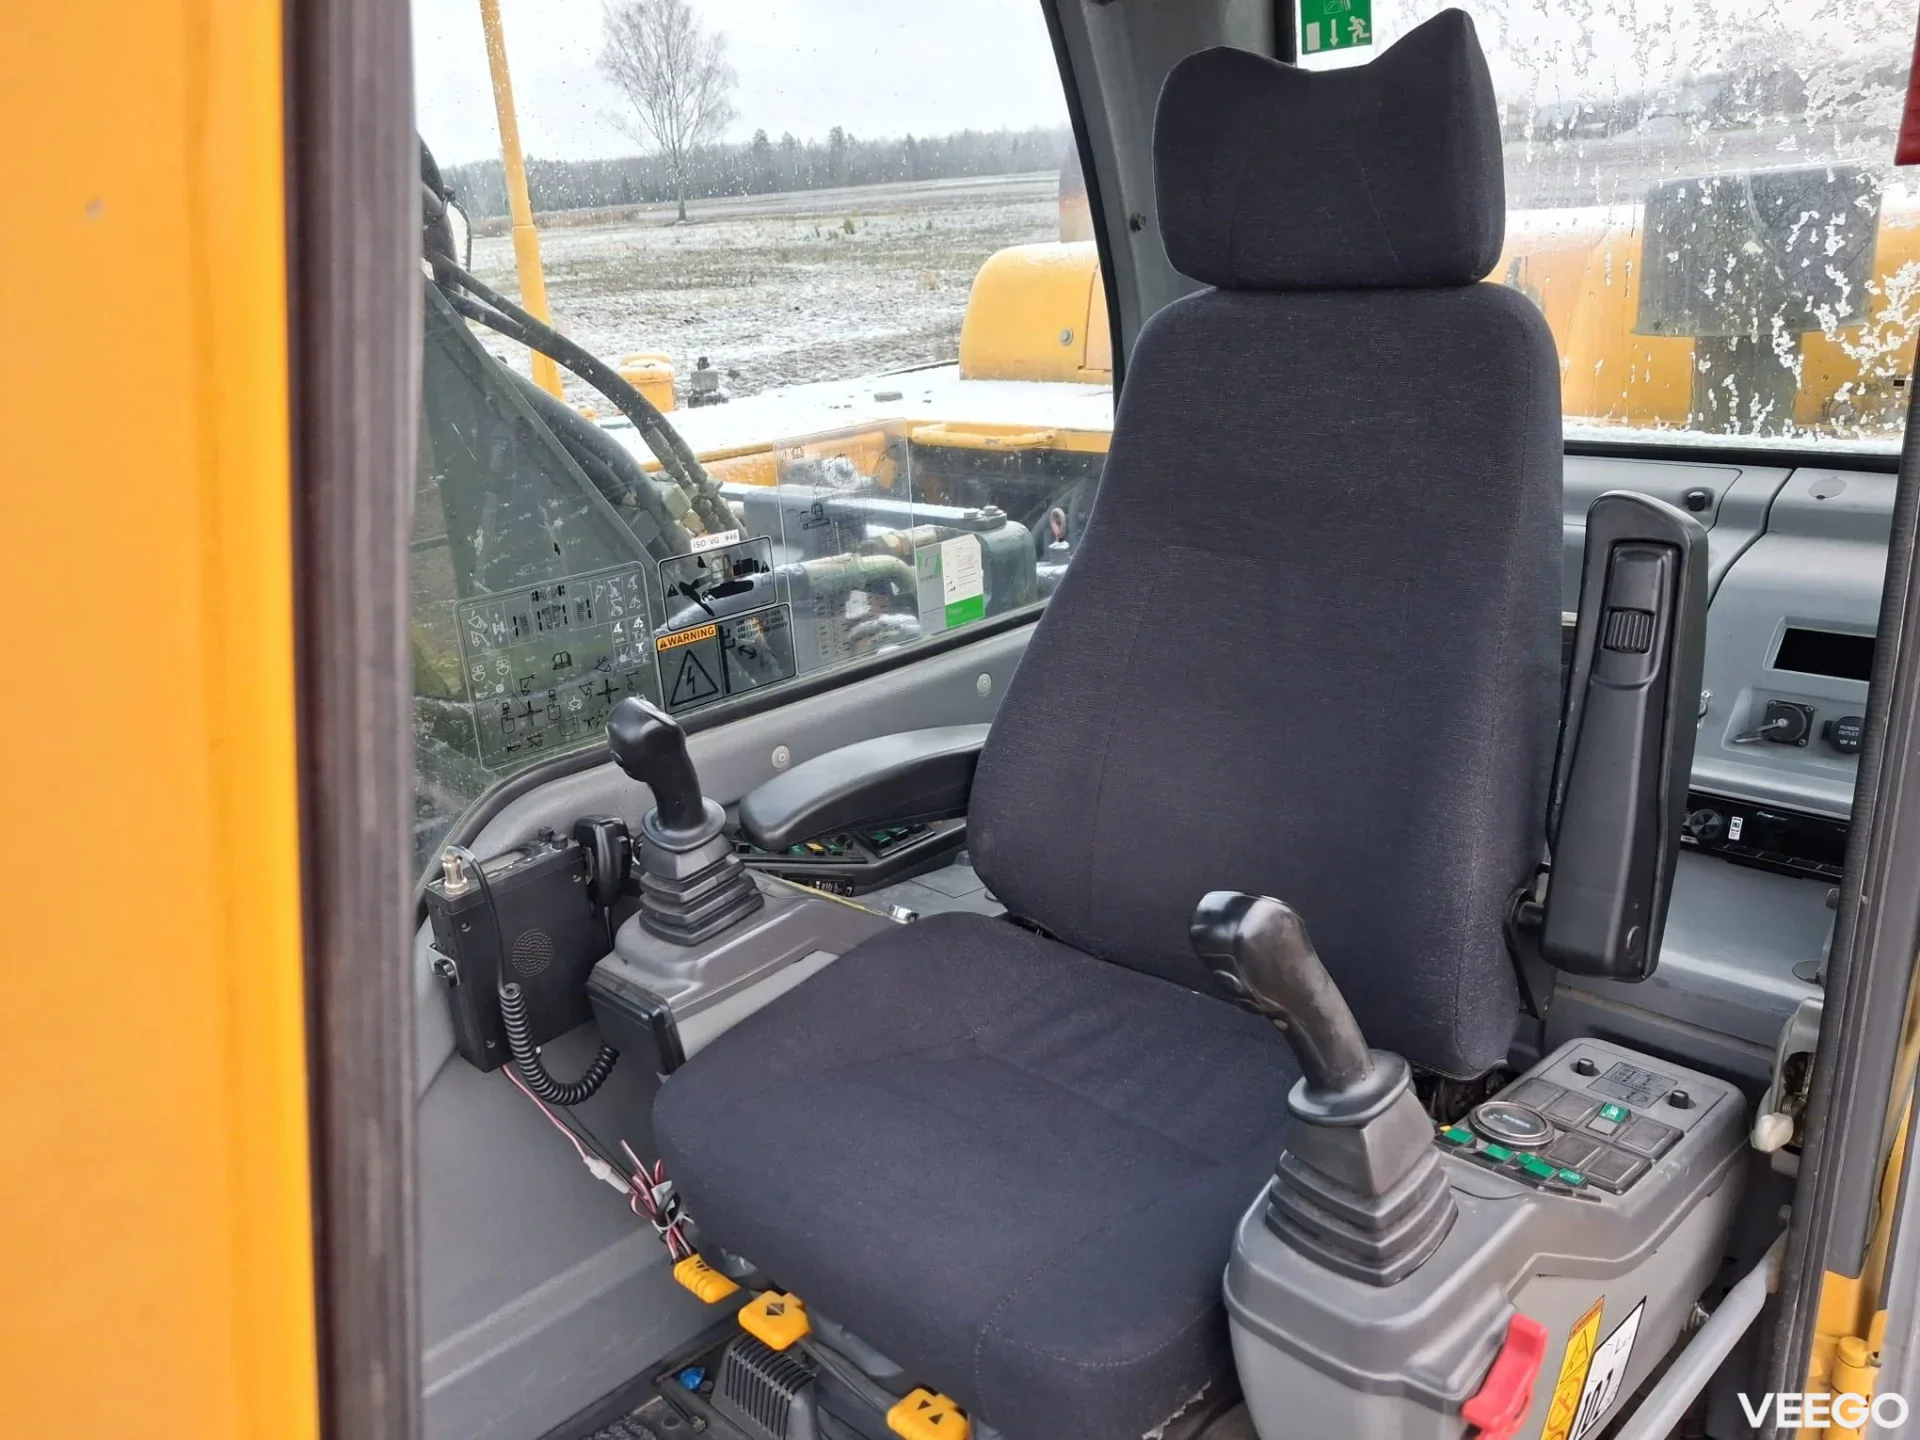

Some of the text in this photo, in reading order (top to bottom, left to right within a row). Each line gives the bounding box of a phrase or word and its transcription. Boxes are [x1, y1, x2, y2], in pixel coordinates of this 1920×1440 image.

[693, 540, 706, 549] ISO
[710, 536, 720, 545] VG
[667, 626, 715, 647] WARNING
